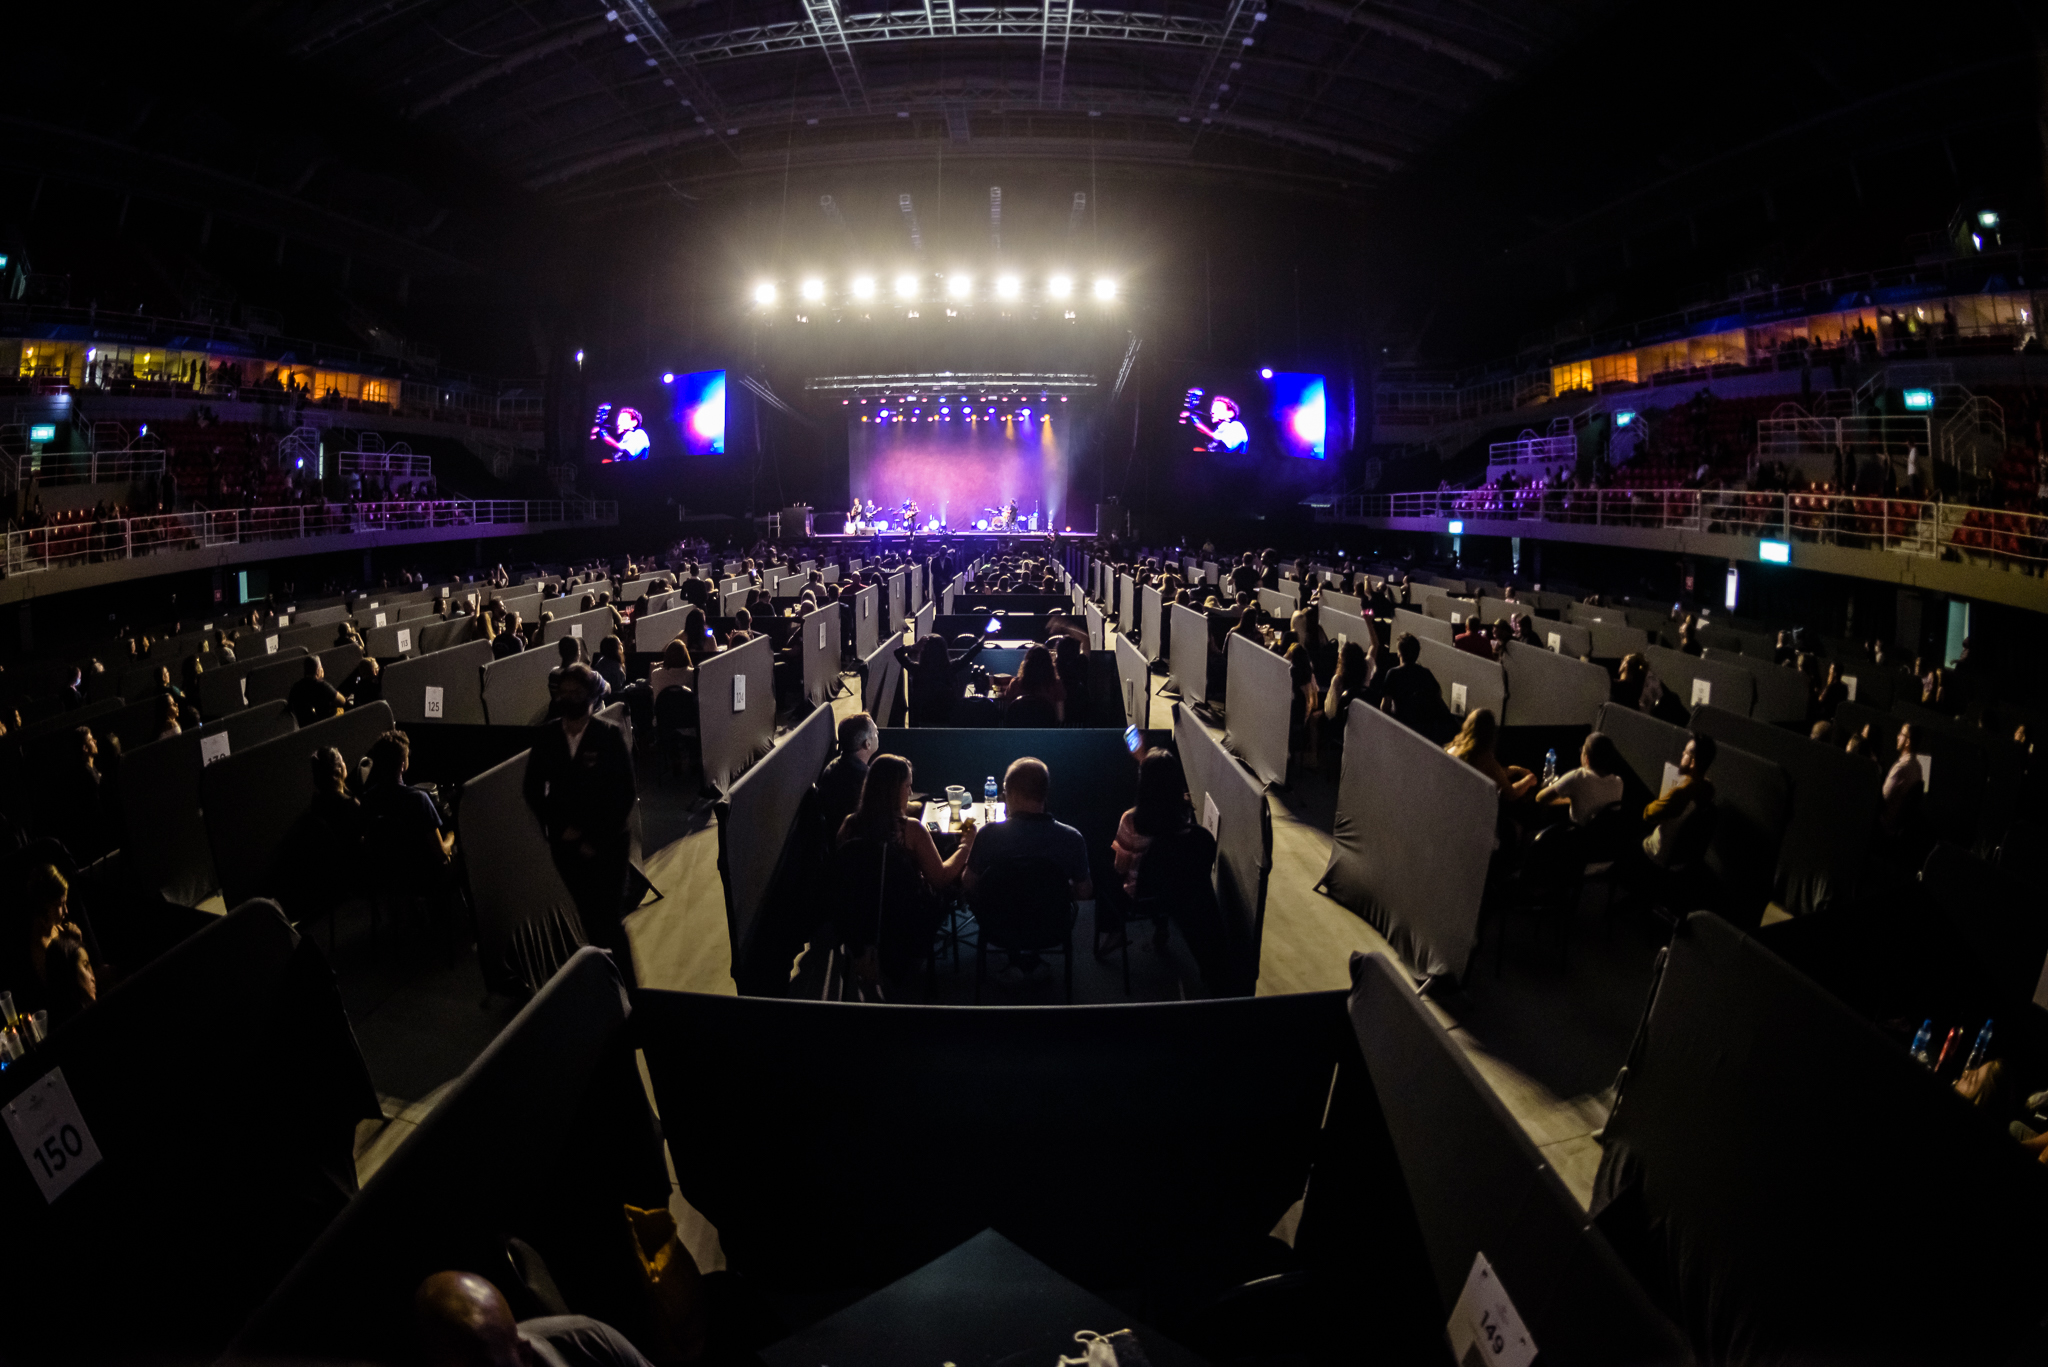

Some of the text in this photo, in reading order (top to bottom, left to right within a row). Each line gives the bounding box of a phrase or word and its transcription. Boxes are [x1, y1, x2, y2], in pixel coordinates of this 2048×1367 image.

[401, 639, 409, 648] 113
[428, 701, 440, 712] 125
[33, 1124, 82, 1179] 150
[1481, 1310, 1504, 1354] 149
